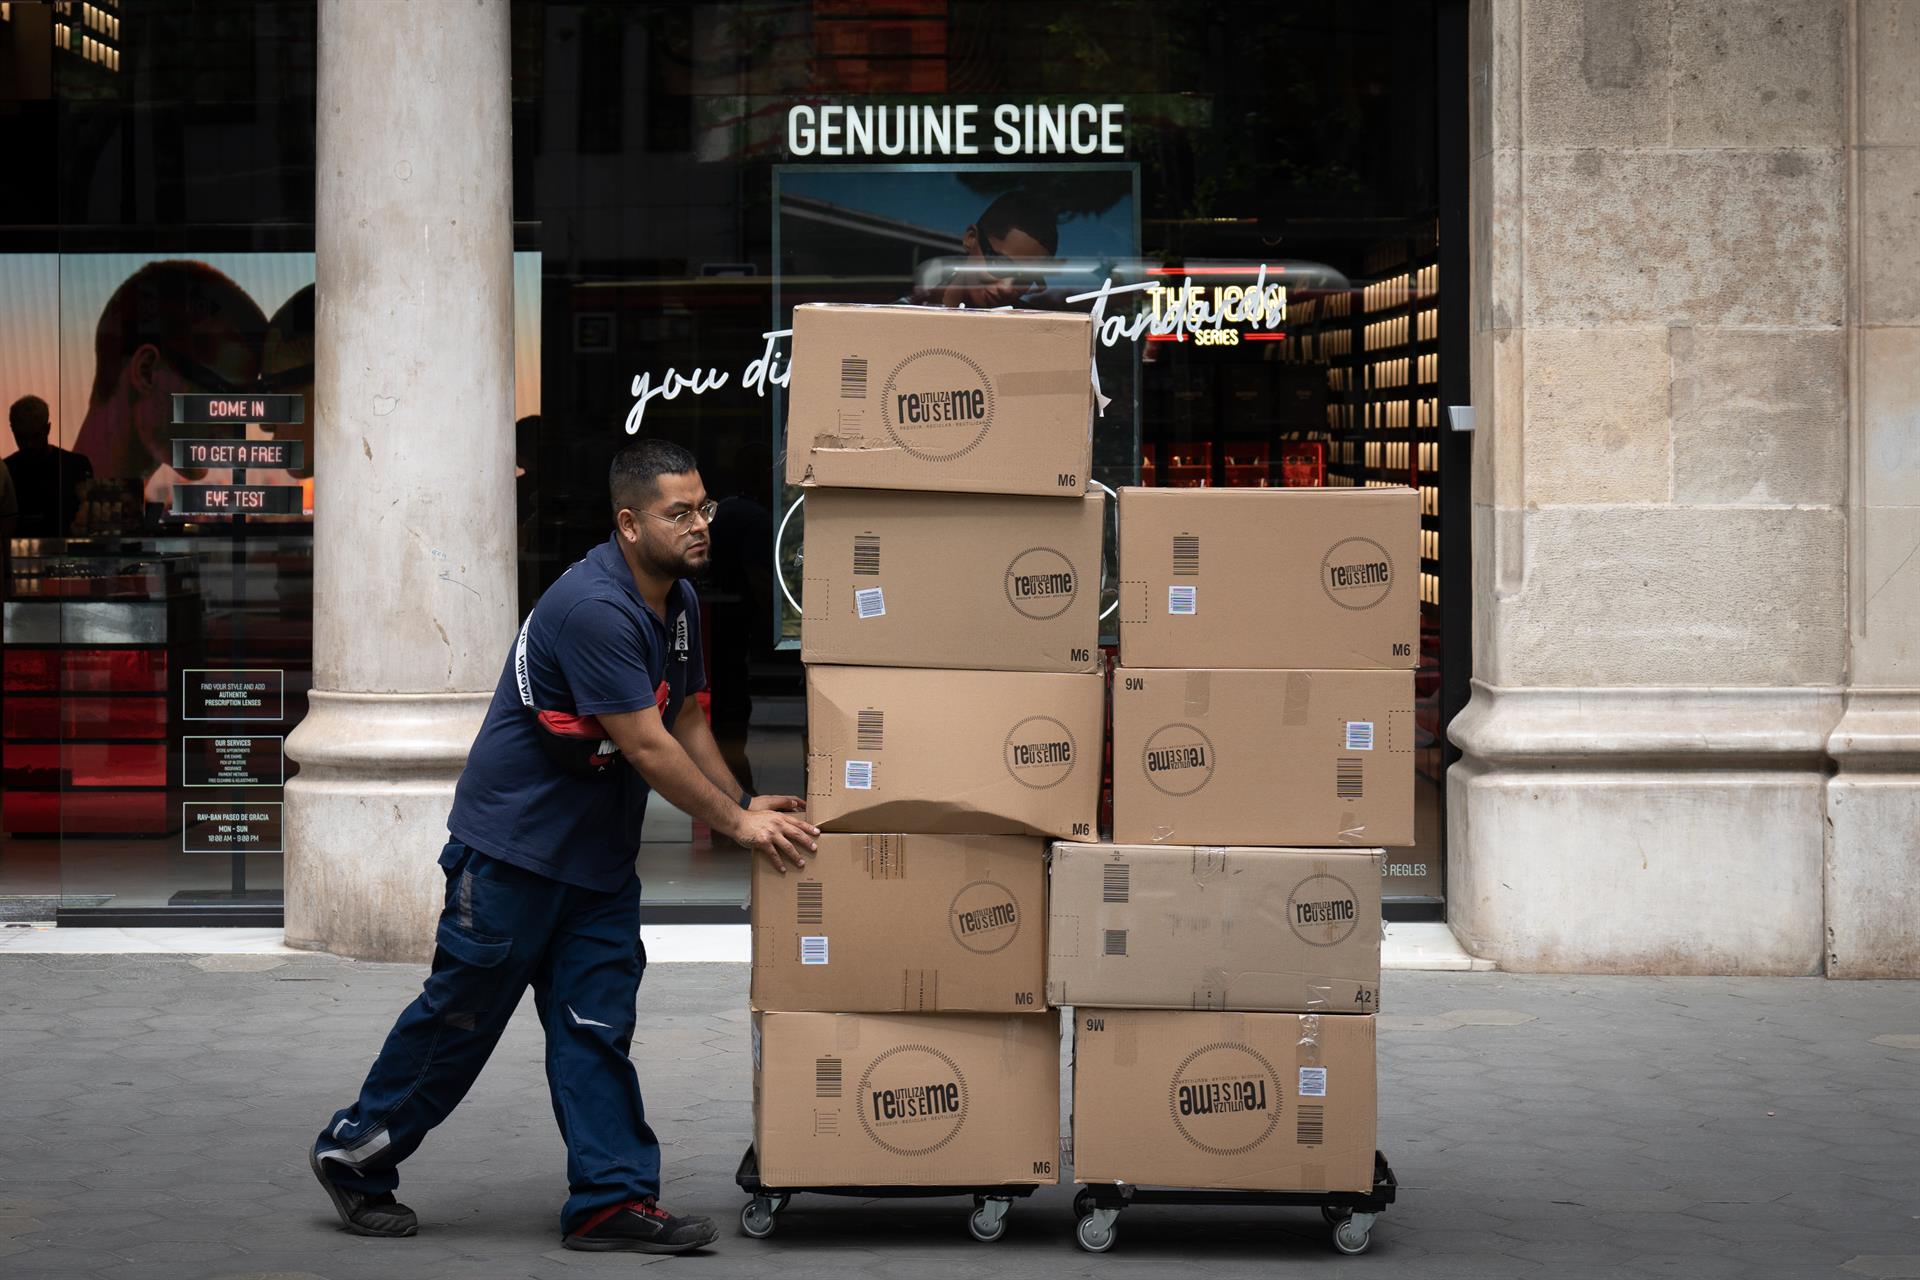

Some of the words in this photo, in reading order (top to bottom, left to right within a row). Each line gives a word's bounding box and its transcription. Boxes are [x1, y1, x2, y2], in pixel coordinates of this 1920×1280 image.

[788, 105, 978, 155] GENUINE
[994, 104, 1124, 154] SINCE
[1146, 286, 1205, 321] THE
[1194, 329, 1239, 346] SERIES
[625, 367, 729, 435] you
[1066, 264, 1287, 347] tandards
[210, 401, 247, 417] COME
[252, 401, 264, 417] IN
[190, 446, 206, 461] TO
[211, 446, 234, 461] GET
[238, 446, 246, 462] A
[251, 446, 282, 462] FREE
[1058, 474, 1076, 487] M6
[206, 491, 229, 506] EYE
[234, 492, 265, 507] TEST
[1071, 649, 1089, 662] M6
[1392, 644, 1410, 656] M6
[1126, 678, 1143, 690] M6
[1073, 824, 1089, 836] M6
[1390, 864, 1426, 876] REGLES
[1015, 992, 1033, 1005] M6
[1354, 990, 1371, 1002] A2
[1087, 1019, 1104, 1031] M6
[1033, 1162, 1050, 1174] M6
